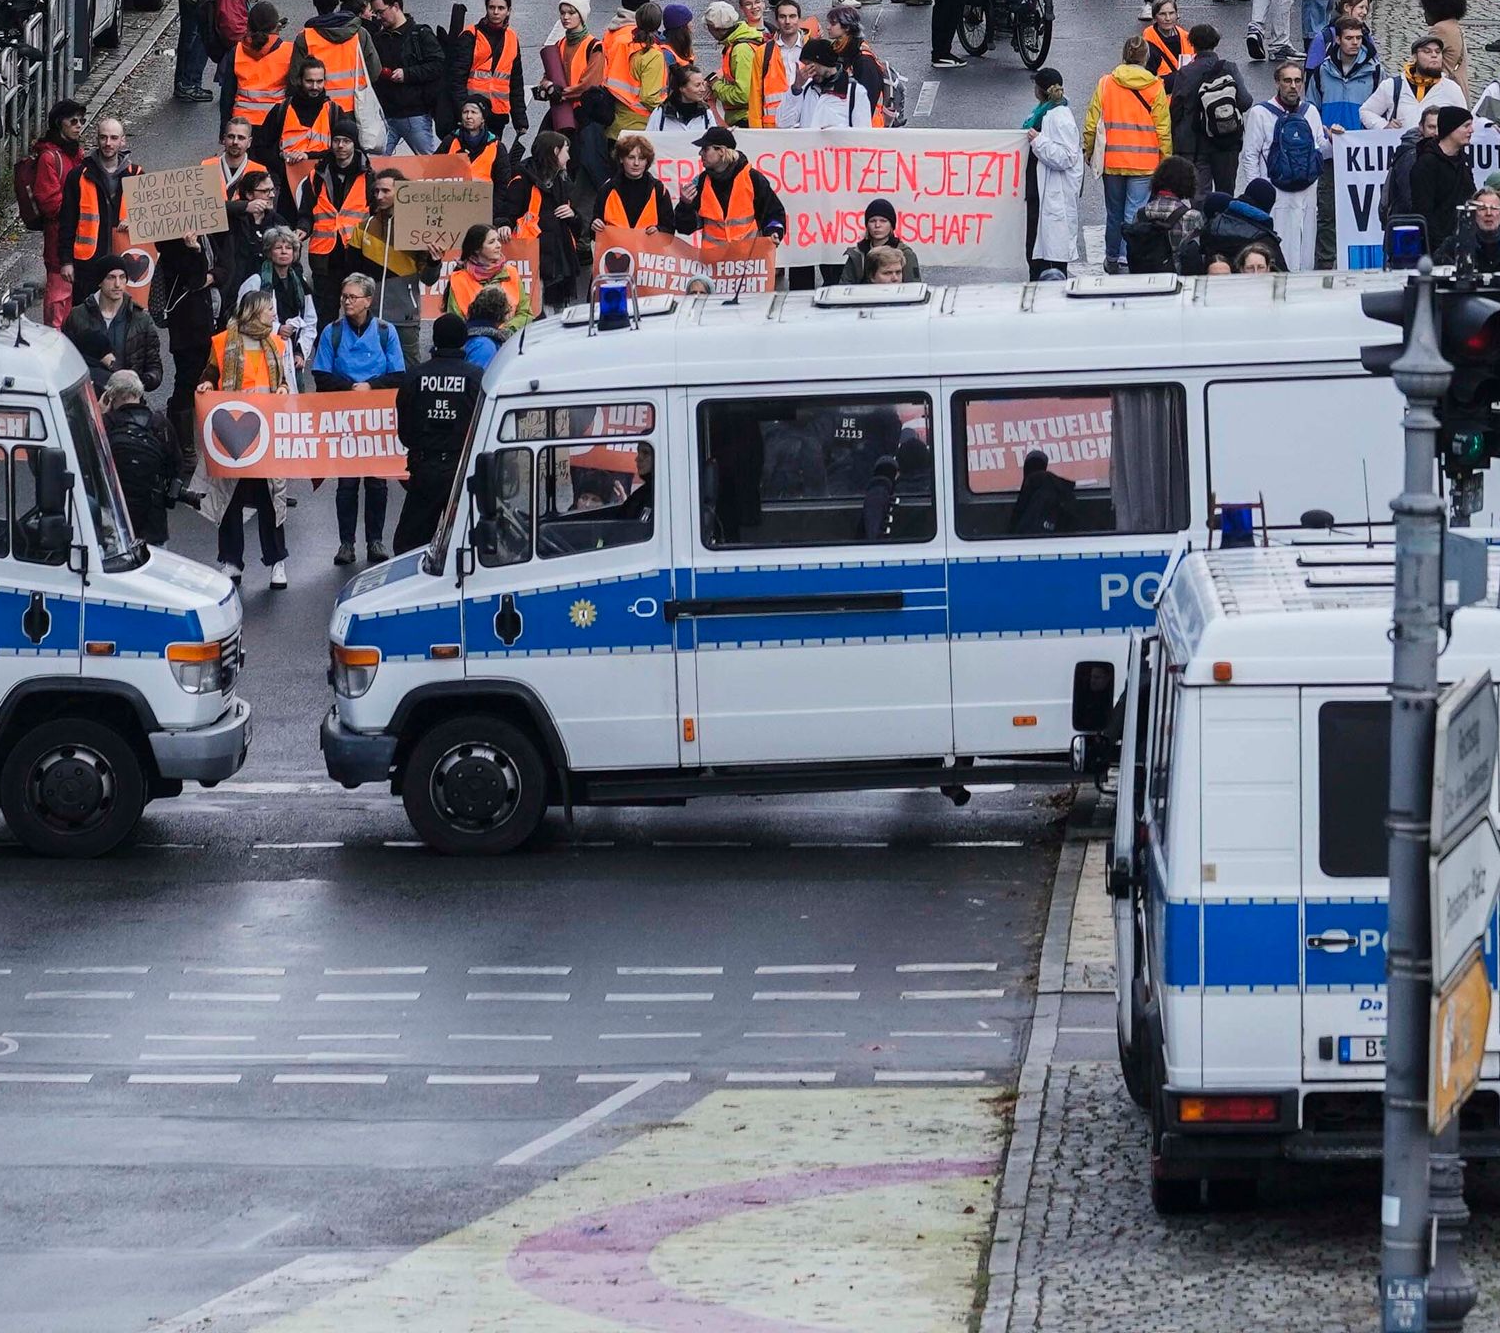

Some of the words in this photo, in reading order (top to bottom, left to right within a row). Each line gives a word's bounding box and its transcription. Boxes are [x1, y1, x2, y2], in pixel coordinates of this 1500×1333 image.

[138, 174, 157, 189] NO
[163, 167, 204, 188] MORE
[132, 184, 205, 205] SUBSIDIES
[128, 205, 150, 222] FOR
[151, 200, 192, 219] FOSSIL
[193, 198, 223, 215] FUEL
[426, 203, 445, 216] rat
[135, 213, 220, 235] COMPANIES
[426, 215, 443, 228] ist
[797, 212, 817, 247] &
[409, 227, 460, 248] sexy
[638, 253, 677, 272] WEG
[679, 258, 714, 276] VON
[716, 259, 768, 275] FOSSIL
[636, 270, 666, 288] HIN
[420, 376, 465, 393] POLIZEI
[427, 409, 457, 421] 12125
[436, 400, 449, 410] BE
[275, 411, 313, 433] DIE
[319, 408, 398, 433] AKTUE
[842, 418, 856, 429] BE
[966, 422, 998, 446] DIE
[275, 436, 320, 459] HAT
[1360, 998, 1383, 1012] Da
